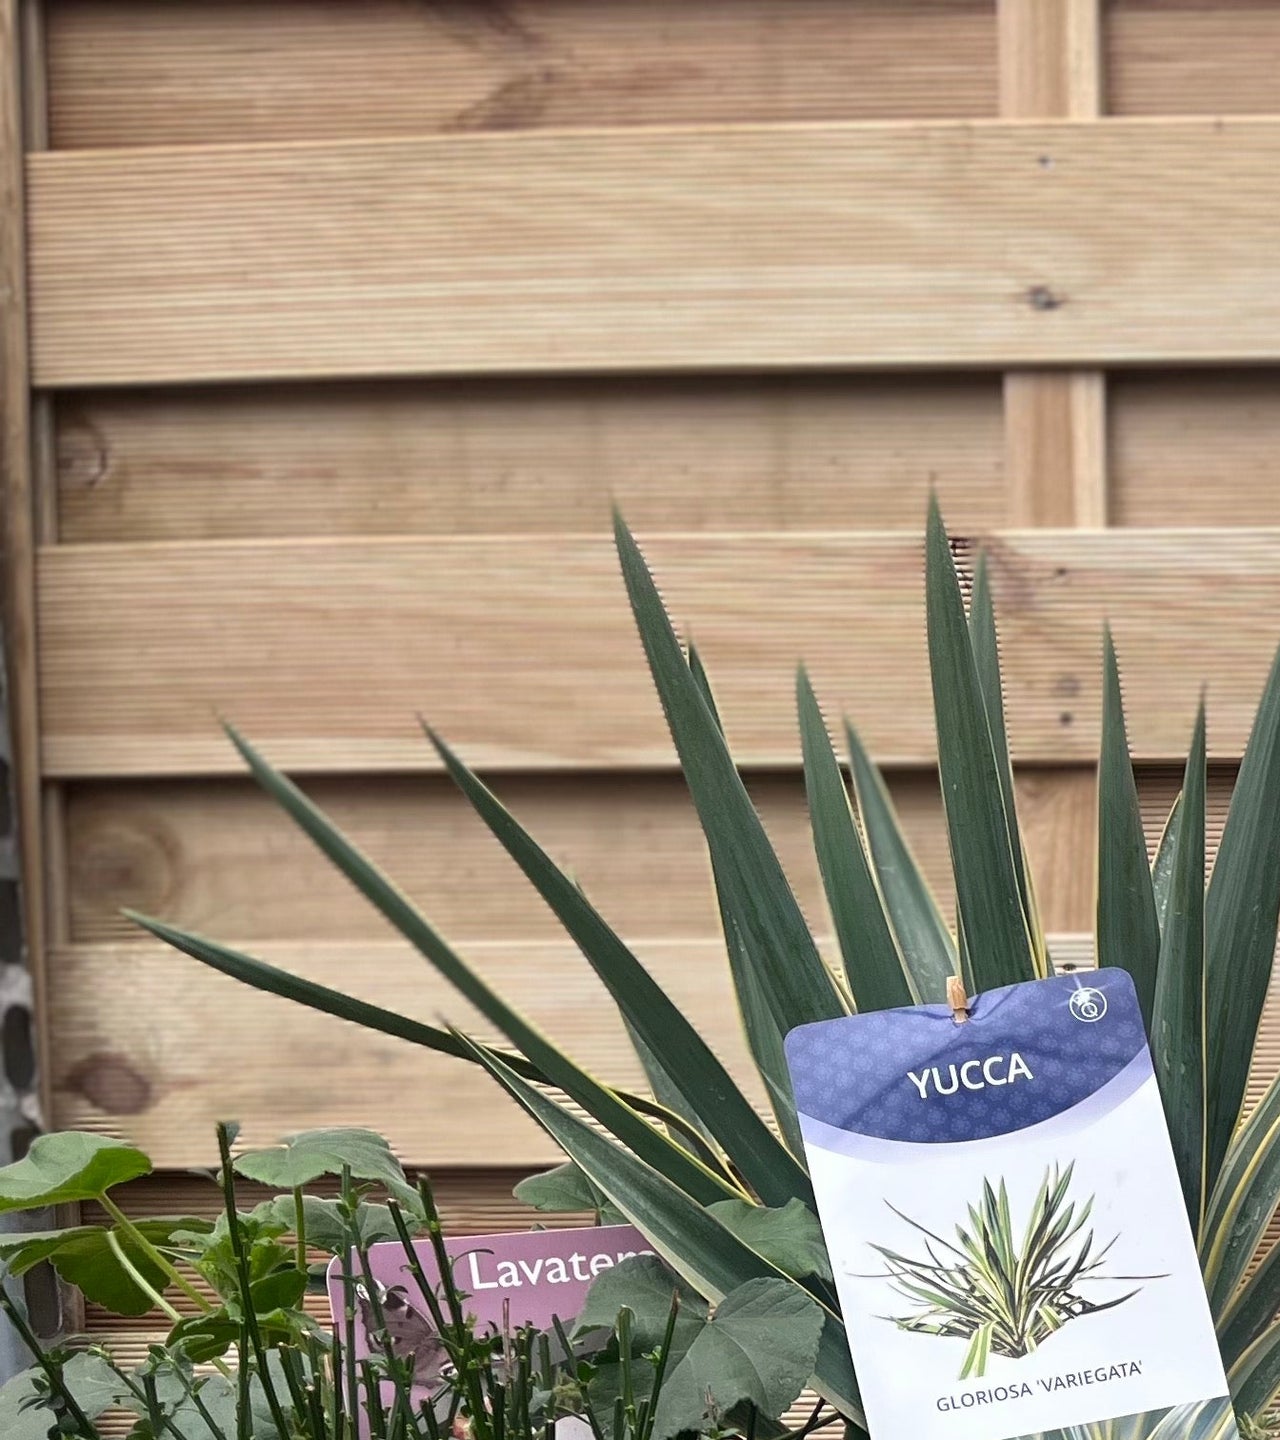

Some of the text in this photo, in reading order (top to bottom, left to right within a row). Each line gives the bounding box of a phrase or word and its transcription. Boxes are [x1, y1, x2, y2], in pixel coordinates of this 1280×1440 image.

[907, 1053, 1033, 1099] YUCCA
[468, 1250, 656, 1290] Lavater
[936, 1360, 1143, 1412] GLORIOSA 'VARIEGATA'
